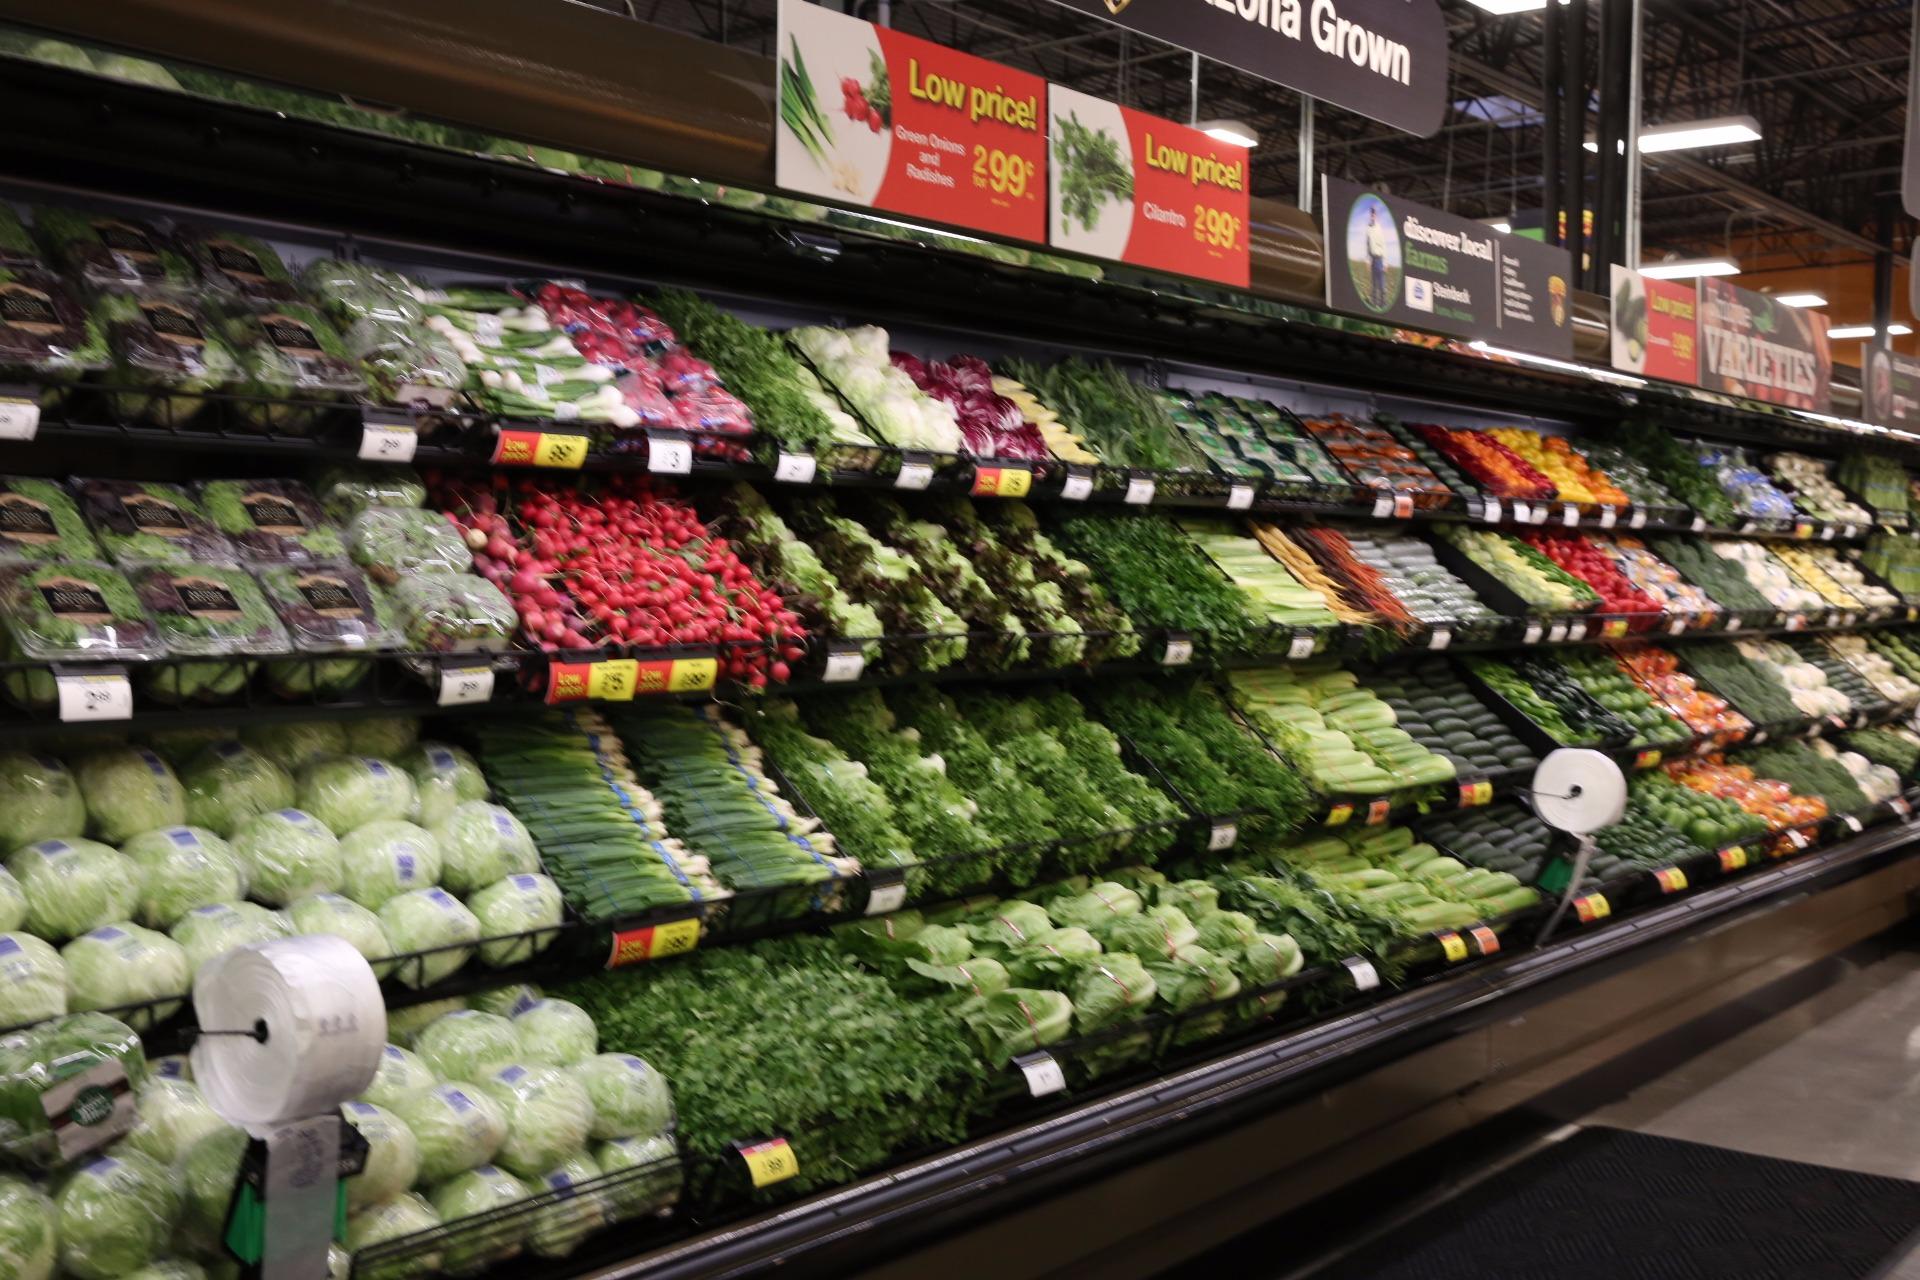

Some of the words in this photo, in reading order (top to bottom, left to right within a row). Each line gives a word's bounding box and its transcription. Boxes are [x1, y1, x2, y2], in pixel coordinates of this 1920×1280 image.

[1310, 0, 1411, 86] Grown
[908, 58, 966, 110] Low
[970, 85, 1037, 131] price!
[895, 124, 929, 147] Green
[1145, 132, 1188, 175] Low
[1191, 152, 1243, 192] price!
[1403, 215, 1462, 253] discover
[1703, 324, 1817, 396] VARIETIES
